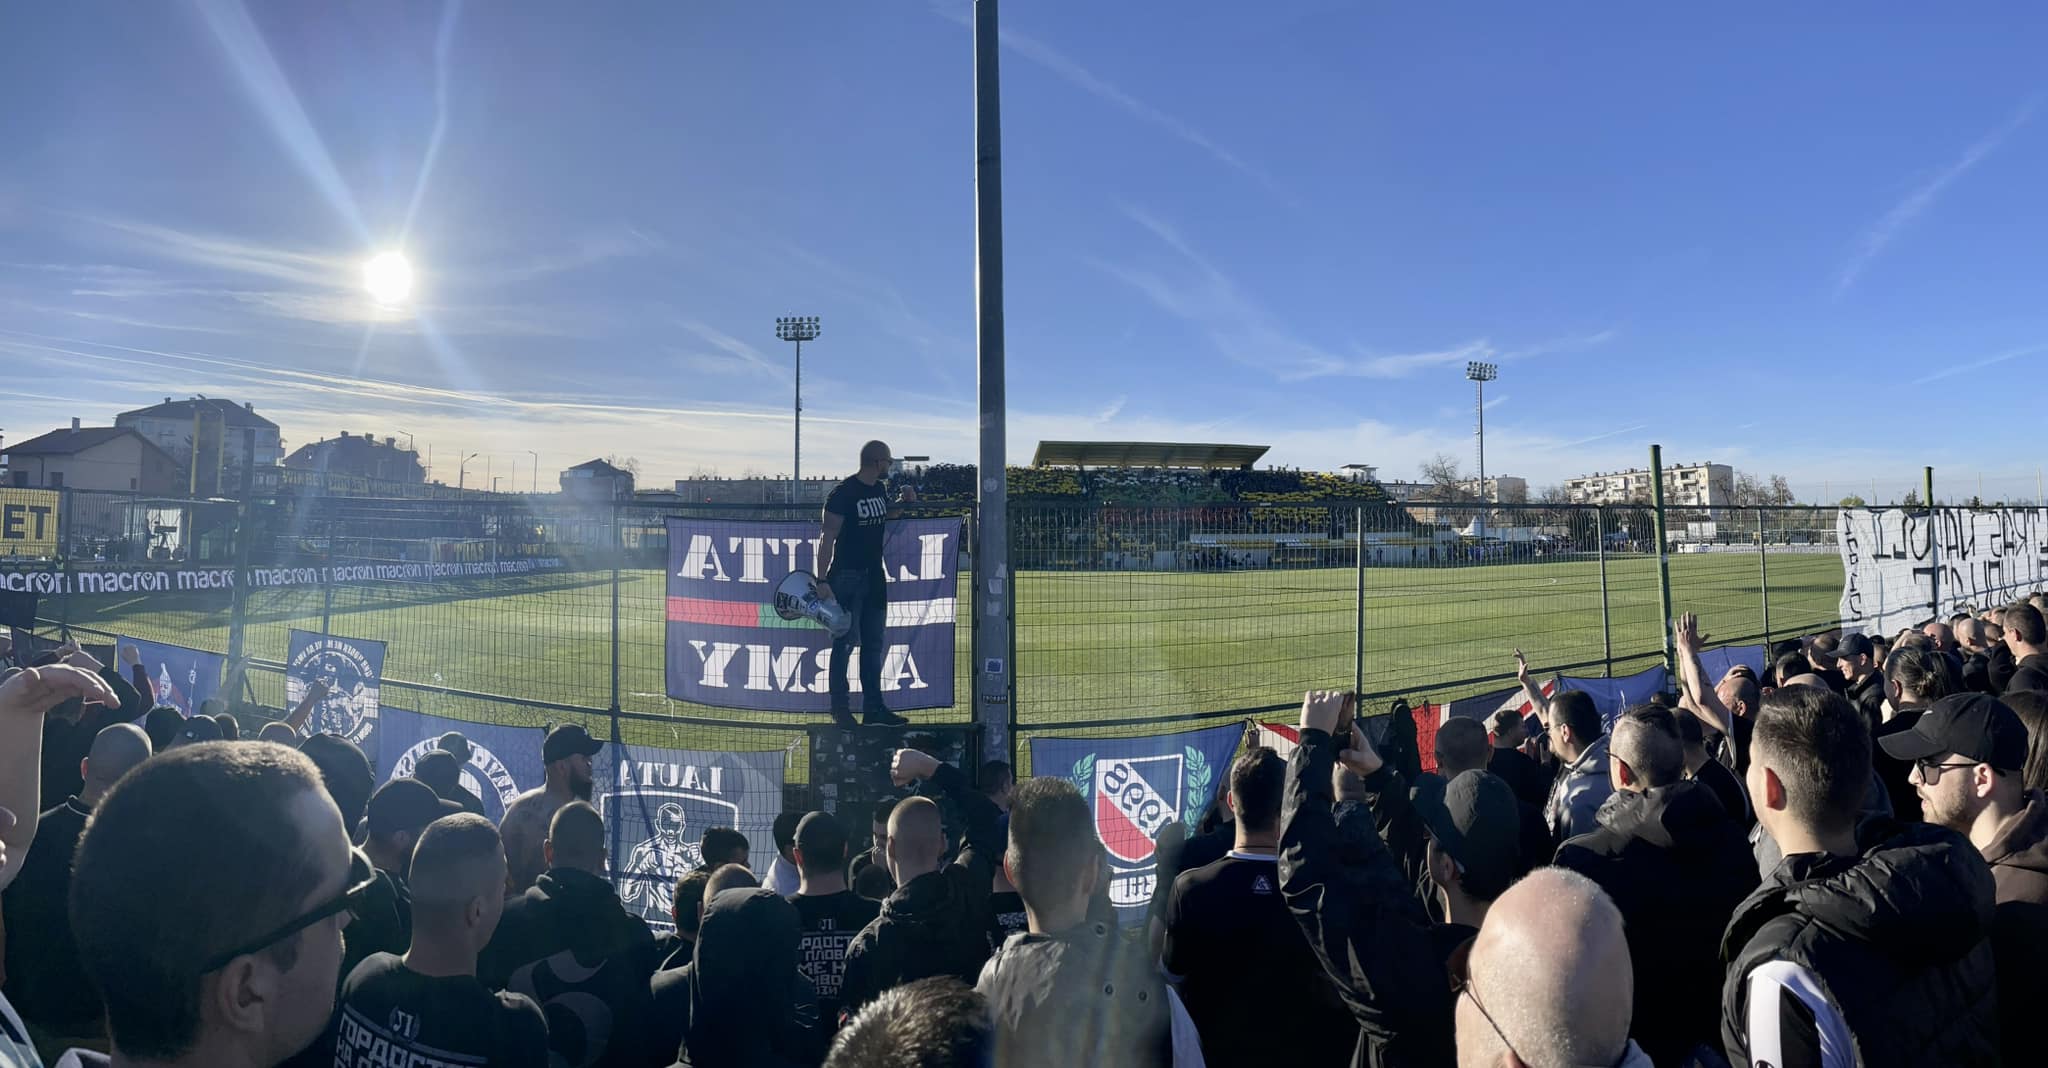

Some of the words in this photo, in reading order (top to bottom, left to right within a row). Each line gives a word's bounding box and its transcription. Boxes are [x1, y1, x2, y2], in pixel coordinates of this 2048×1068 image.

[3, 503, 51, 540] ET
[0, 571, 72, 594] cron
[78, 571, 170, 592] macron
[177, 570, 252, 589] macr
[255, 566, 317, 586] macron
[376, 563, 422, 579] macron
[801, 935, 854, 950] РДОСТ
[805, 949, 844, 960] ПЛОВ
